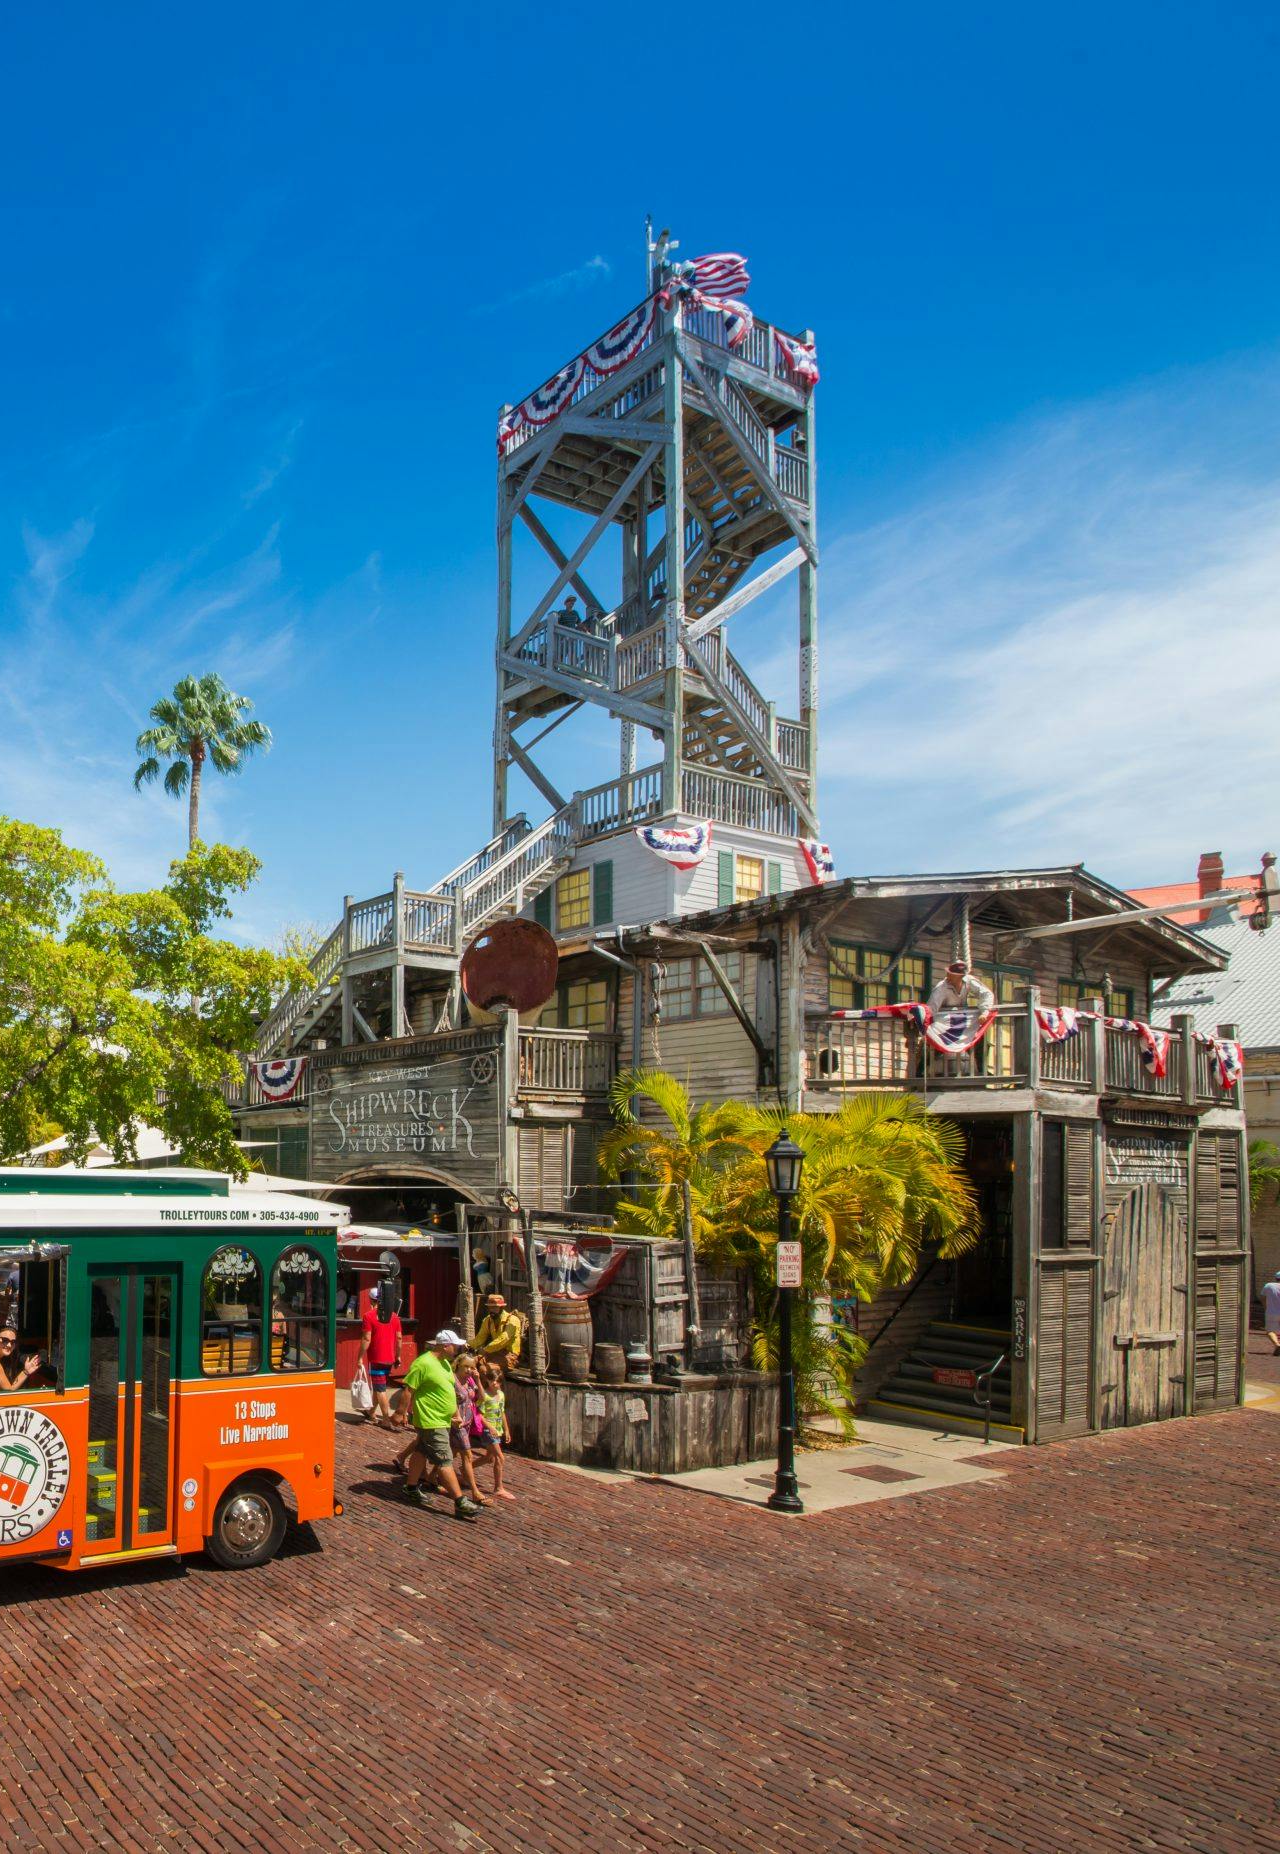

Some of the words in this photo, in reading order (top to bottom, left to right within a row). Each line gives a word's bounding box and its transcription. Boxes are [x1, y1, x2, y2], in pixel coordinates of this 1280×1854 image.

[397, 1066, 431, 1080] WEST
[328, 1087, 481, 1159] SHIPWRECK
[359, 1121, 434, 1137] TREASURES
[348, 1137, 447, 1153] MUSEUM
[1121, 1172, 1170, 1183] MUSEUM
[260, 1211, 320, 1221] 305-434-4900
[783, 1245, 795, 1253] NO
[235, 1401, 248, 1419] 13
[250, 1400, 276, 1420] Stops
[221, 1427, 240, 1445] Live
[243, 1422, 288, 1443] Narration
[33, 1419, 68, 1509] TROLLEY
